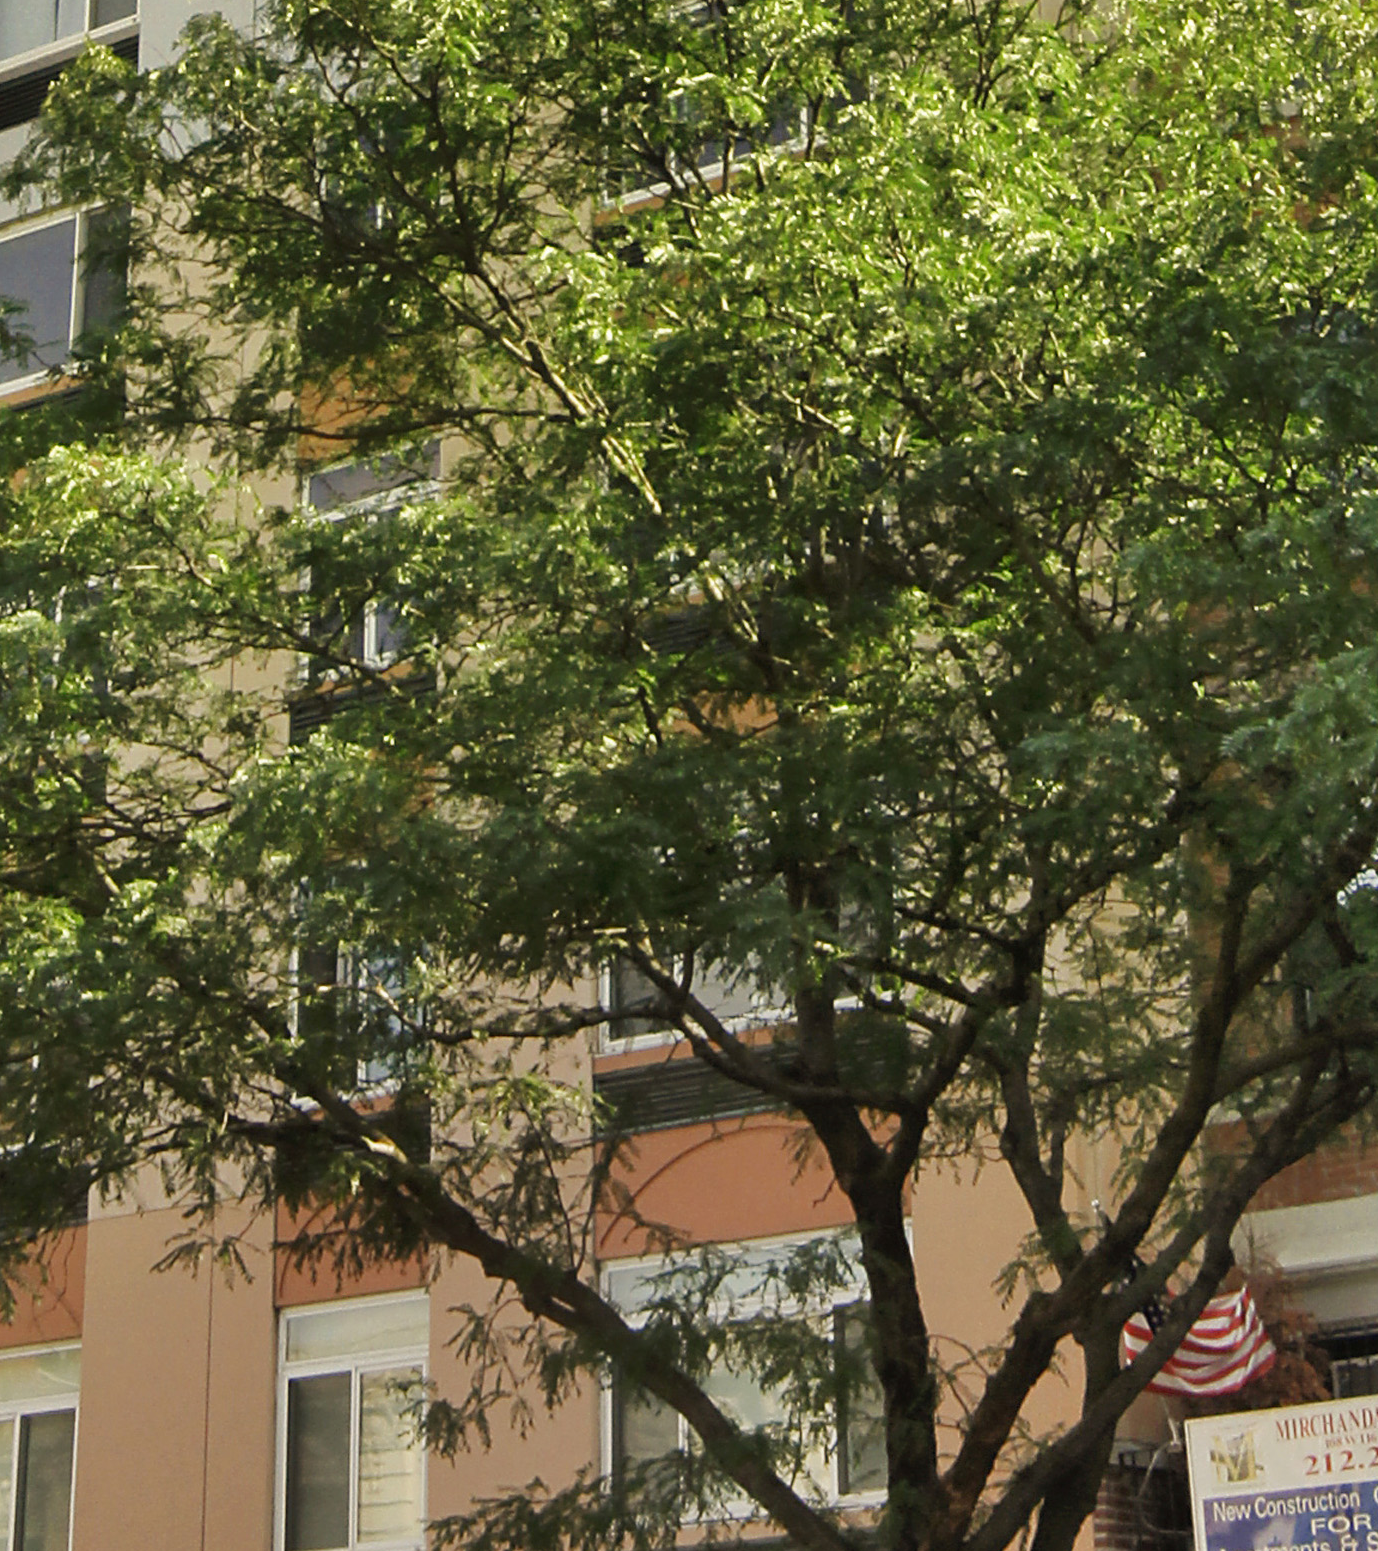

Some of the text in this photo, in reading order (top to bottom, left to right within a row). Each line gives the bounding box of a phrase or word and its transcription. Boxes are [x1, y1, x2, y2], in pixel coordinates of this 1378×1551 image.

[1213, 1501, 1252, 1522] New
[1255, 1489, 1361, 1518] Construction
[1311, 1514, 1373, 1537] FOR
